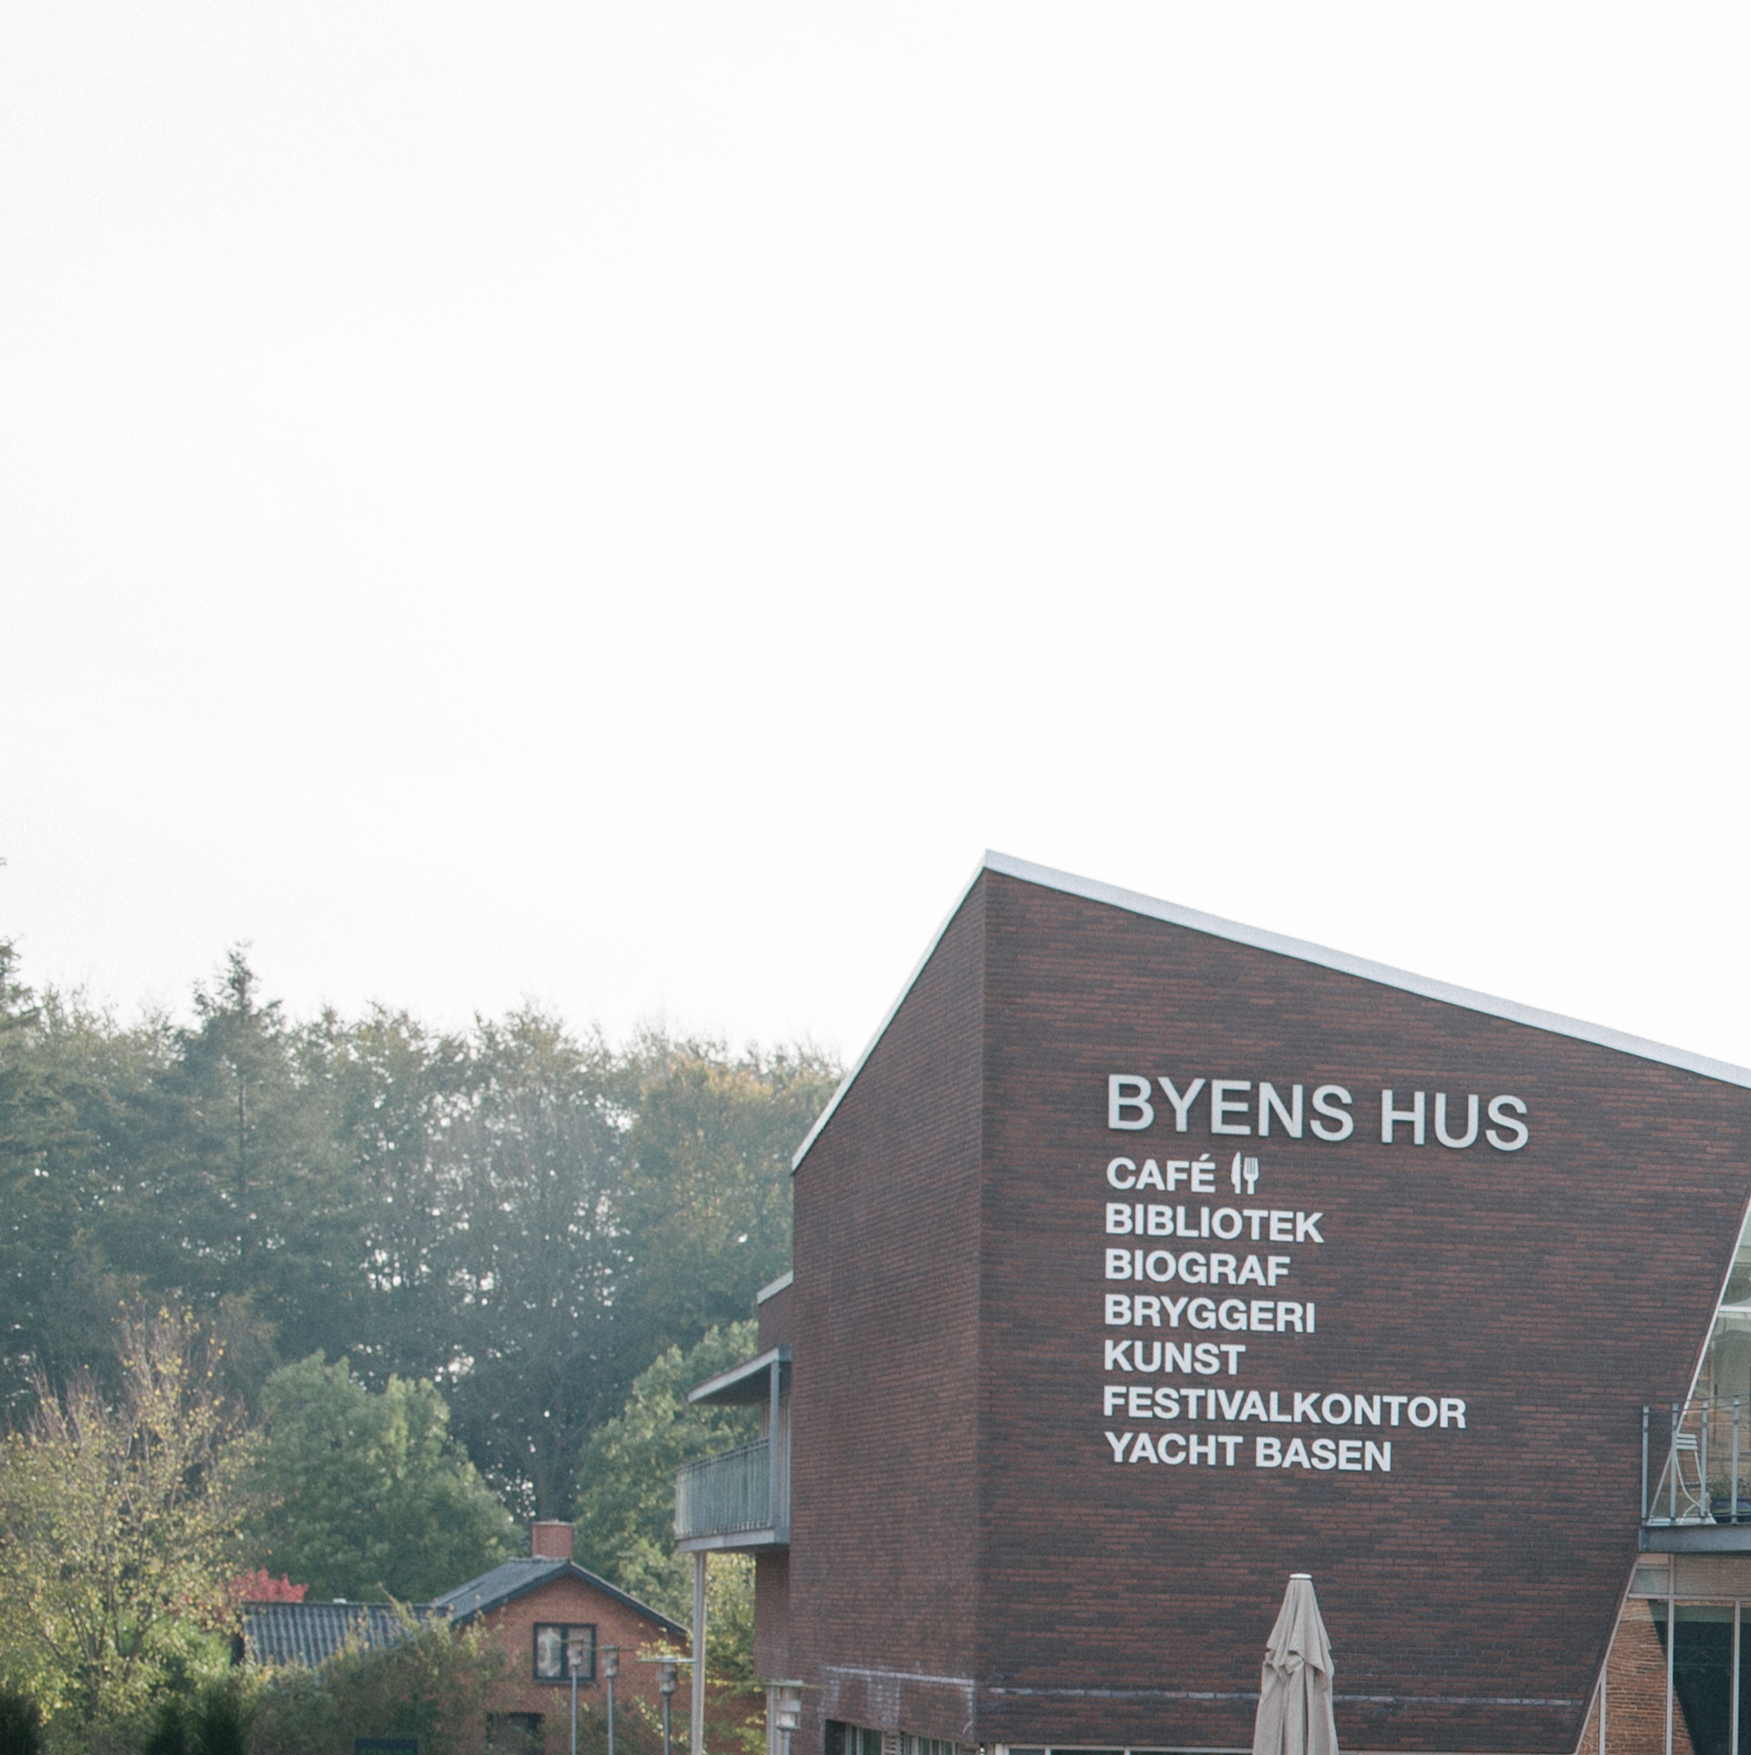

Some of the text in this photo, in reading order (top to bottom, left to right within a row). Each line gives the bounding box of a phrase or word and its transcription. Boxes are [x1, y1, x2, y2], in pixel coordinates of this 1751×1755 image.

[1107, 1074, 1529, 1151] BYENS HUS
[1106, 1153, 1216, 1193] CAFÉ
[1105, 1203, 1324, 1243] BIBLIOTEK
[1104, 1248, 1290, 1287] BIOGRAF
[1103, 1294, 1315, 1333] BRYGGERI
[1104, 1340, 1245, 1375] KUNST
[1103, 1386, 1466, 1429] FESTIVALKONTOR
[1105, 1432, 1391, 1471] YACHT BASEN
